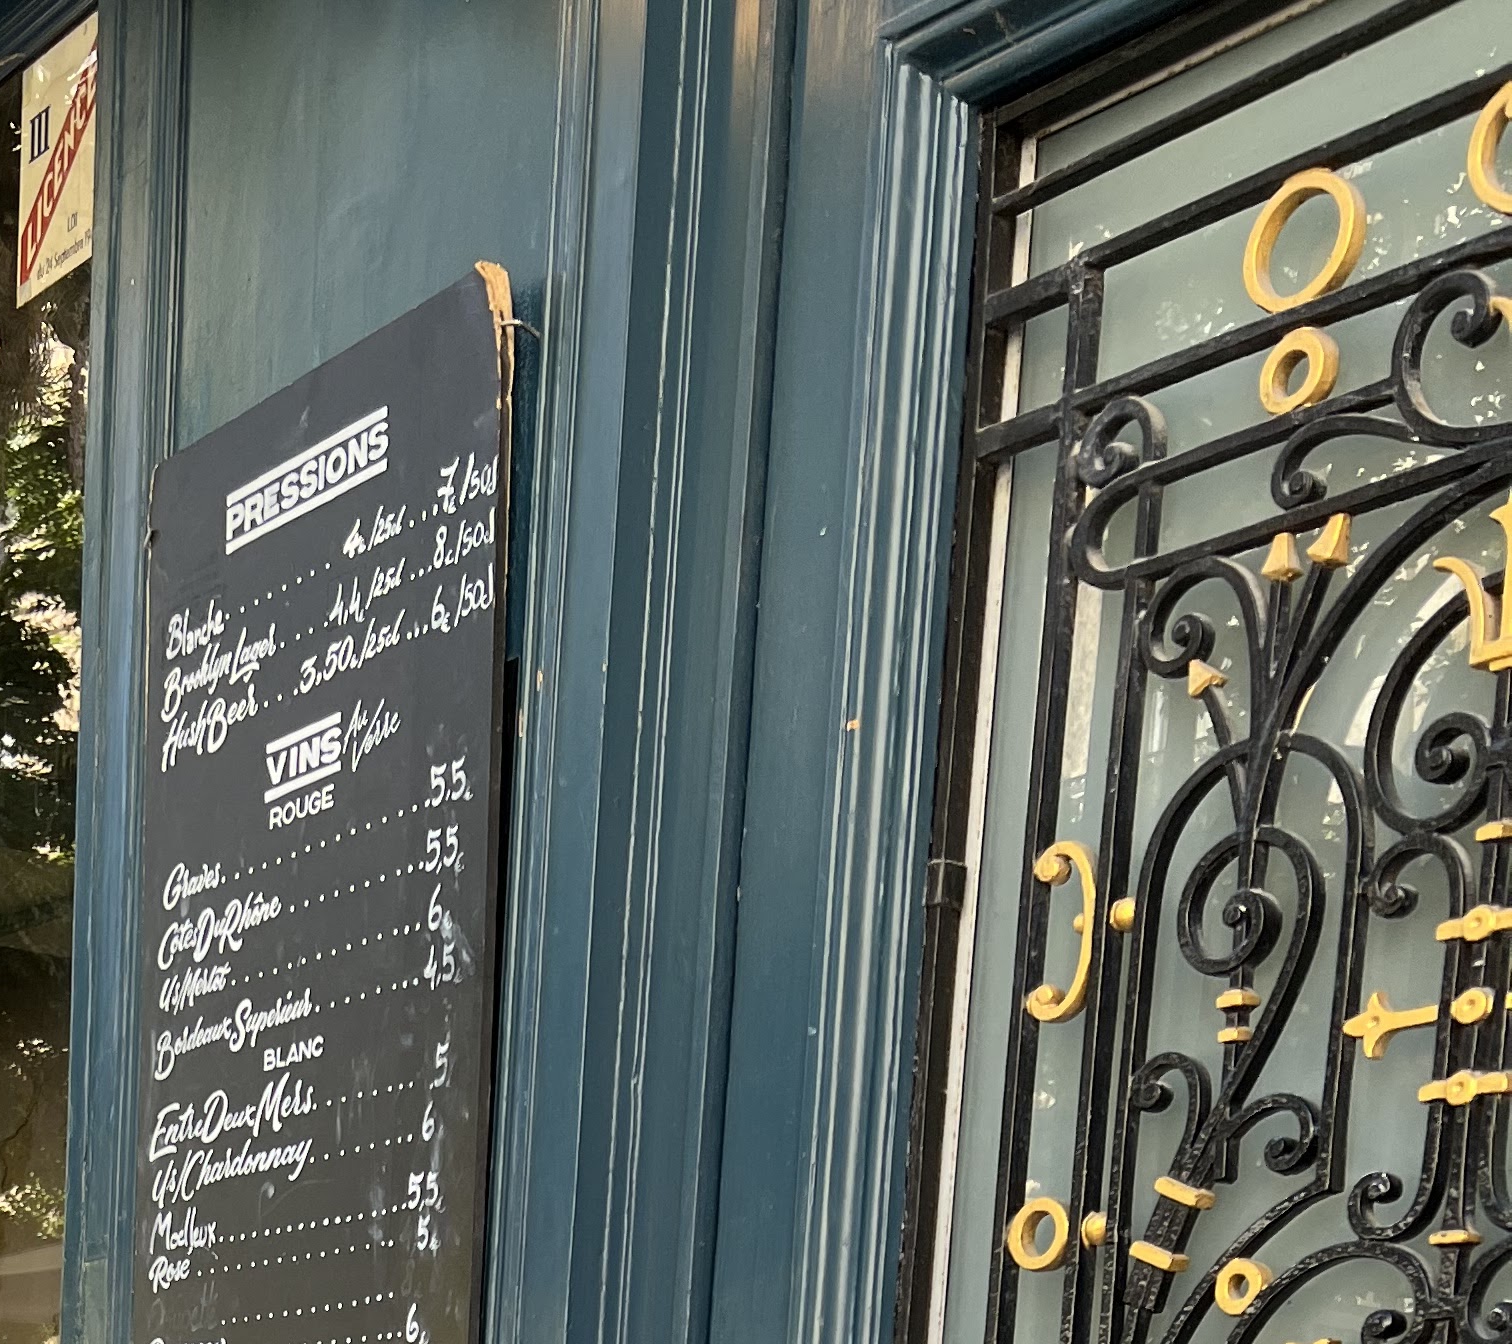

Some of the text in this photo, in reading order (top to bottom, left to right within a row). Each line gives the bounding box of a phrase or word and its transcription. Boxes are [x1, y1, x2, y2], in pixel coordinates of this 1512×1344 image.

[29, 104, 51, 164] III
[25, 64, 97, 270] LICENCE
[227, 422, 389, 541] PRESSIONS
[166, 600, 225, 660] Blanche
[266, 727, 342, 785] VINS
[344, 700, 368, 754] Au
[268, 784, 335, 829] ROUGE
[163, 863, 221, 911] Graves
[154, 1016, 232, 1081] Bordeaux
[263, 1036, 324, 1071] BLANC
